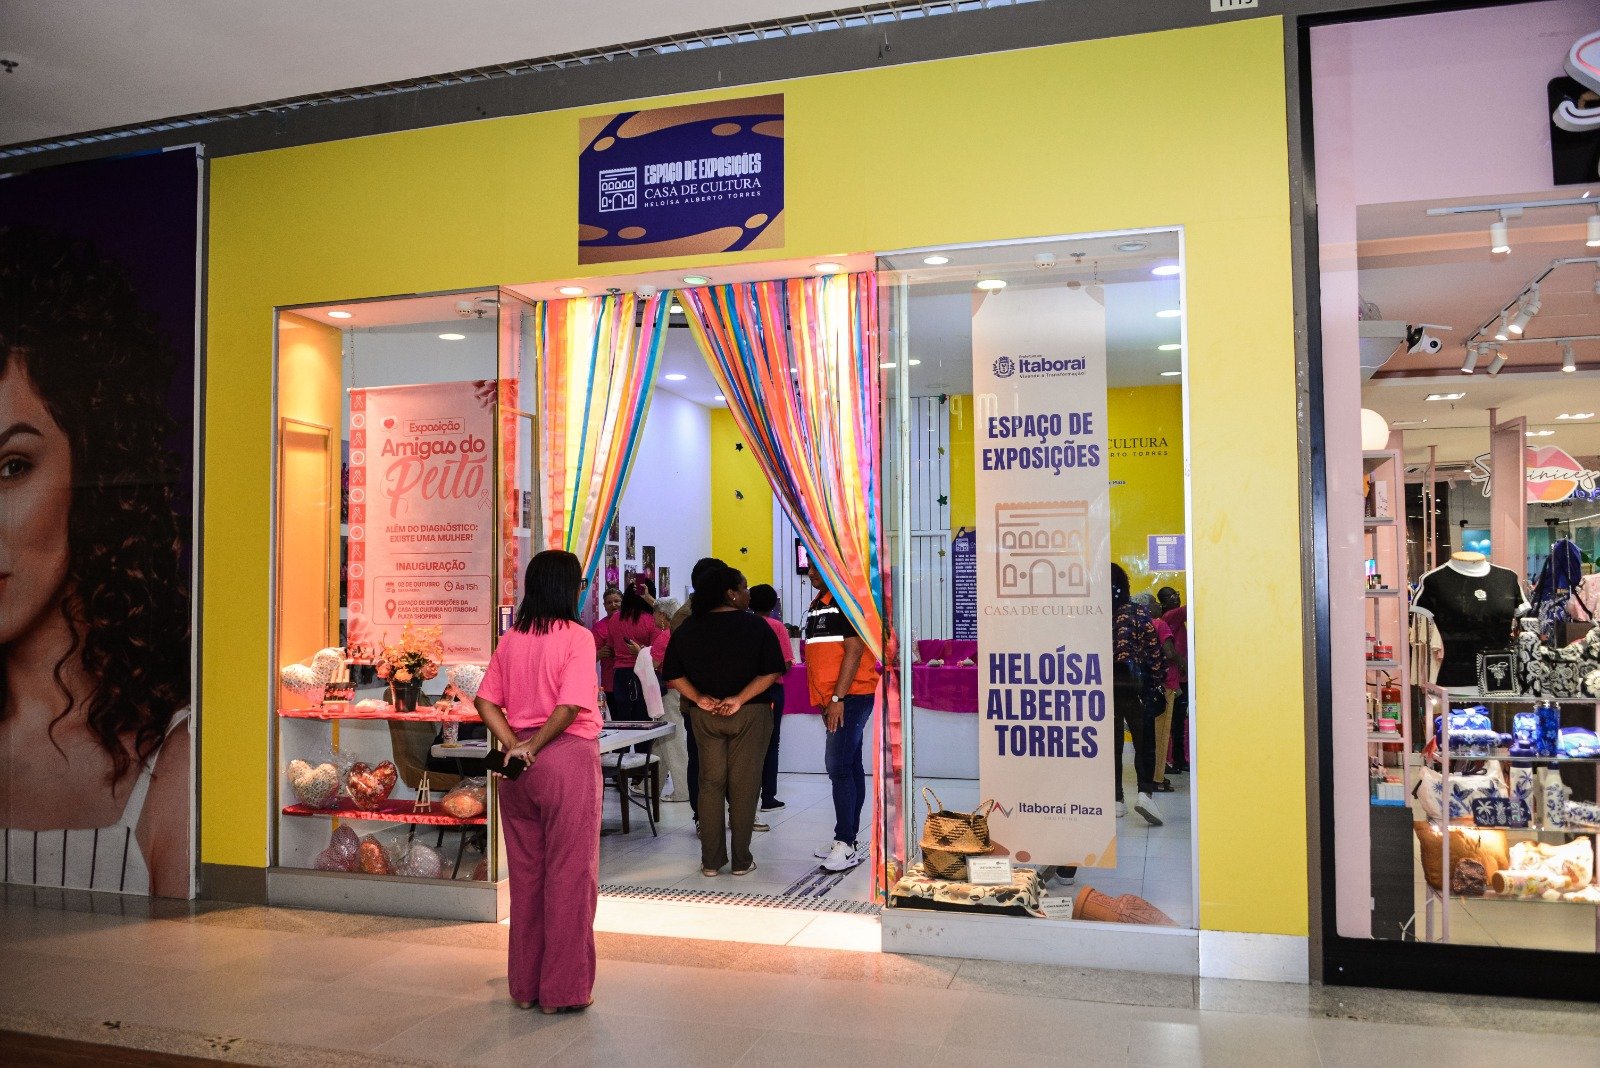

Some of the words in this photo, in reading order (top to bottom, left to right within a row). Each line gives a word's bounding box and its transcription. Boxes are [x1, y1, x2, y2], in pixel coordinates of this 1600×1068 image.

[644, 161, 683, 185] ESPAÇO
[684, 159, 698, 181] DE
[698, 152, 762, 179] EXPOSIÇÕES
[644, 185, 679, 200] CASA
[680, 182, 698, 196] DE
[700, 178, 762, 194] CULTURA
[644, 199, 680, 208] HELOÍSA
[684, 194, 723, 204] ALBERTO
[727, 190, 762, 199] TORRES
[1018, 355, 1086, 373] Itaboraí
[409, 420, 460, 435] Exposição
[988, 413, 1062, 444] ESPAÇO
[1069, 412, 1093, 436] DE
[381, 437, 457, 460] Amigas
[459, 434, 486, 454] do
[982, 440, 1100, 476] EXPOSIÇÕES
[384, 454, 488, 519] Peito
[385, 523, 406, 533] ALÉM
[407, 525, 419, 533] DO
[420, 523, 478, 533] DIAGNÓSTICO:
[390, 535, 416, 543] EXISTE
[416, 534, 436, 542] UMA
[437, 533, 473, 542] MULHER!
[396, 559, 466, 573] INAUGURAÇÃO
[465, 583, 479, 591] 15h
[397, 599, 418, 607] ESPAÇO
[426, 599, 460, 607] EXPOSIÇÕES
[452, 605, 478, 613] ITABORAÍ
[984, 605, 1020, 616] CASA
[1020, 605, 1038, 616] DE
[1041, 604, 1104, 616] CULTURA
[989, 645, 1102, 685] HELOÍSA
[986, 689, 1106, 722] ALBERTO
[994, 725, 1099, 759] TORRES
[1018, 802, 1067, 814] Itaboraí
[1070, 804, 1103, 816] Plaza
